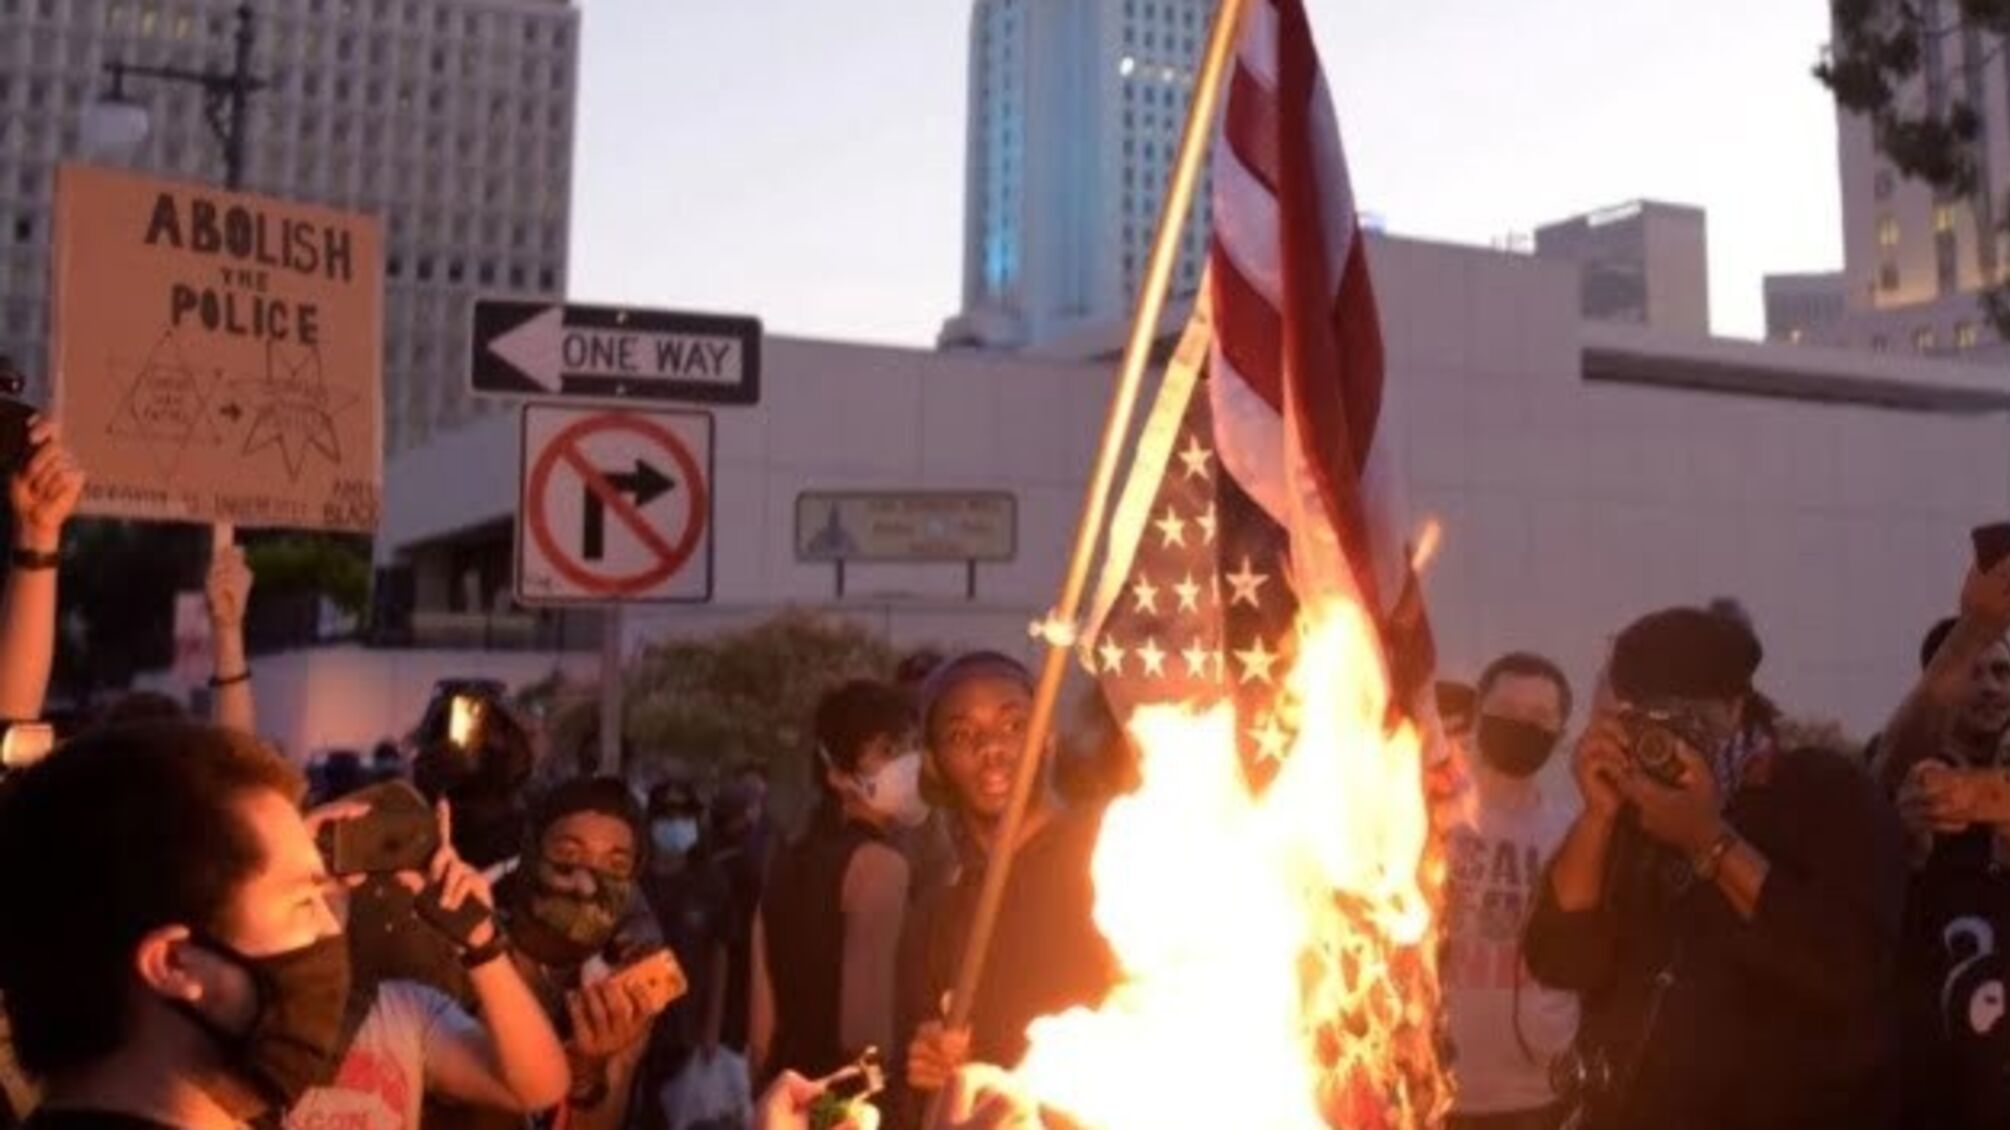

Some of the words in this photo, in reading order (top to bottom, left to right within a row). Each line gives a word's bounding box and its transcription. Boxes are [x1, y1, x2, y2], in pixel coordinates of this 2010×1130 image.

[144, 193, 352, 282] ABOLISH
[220, 266, 269, 293] THE
[171, 284, 319, 346] POLICE
[562, 332, 639, 371] ONE
[656, 335, 731, 377] WAY
